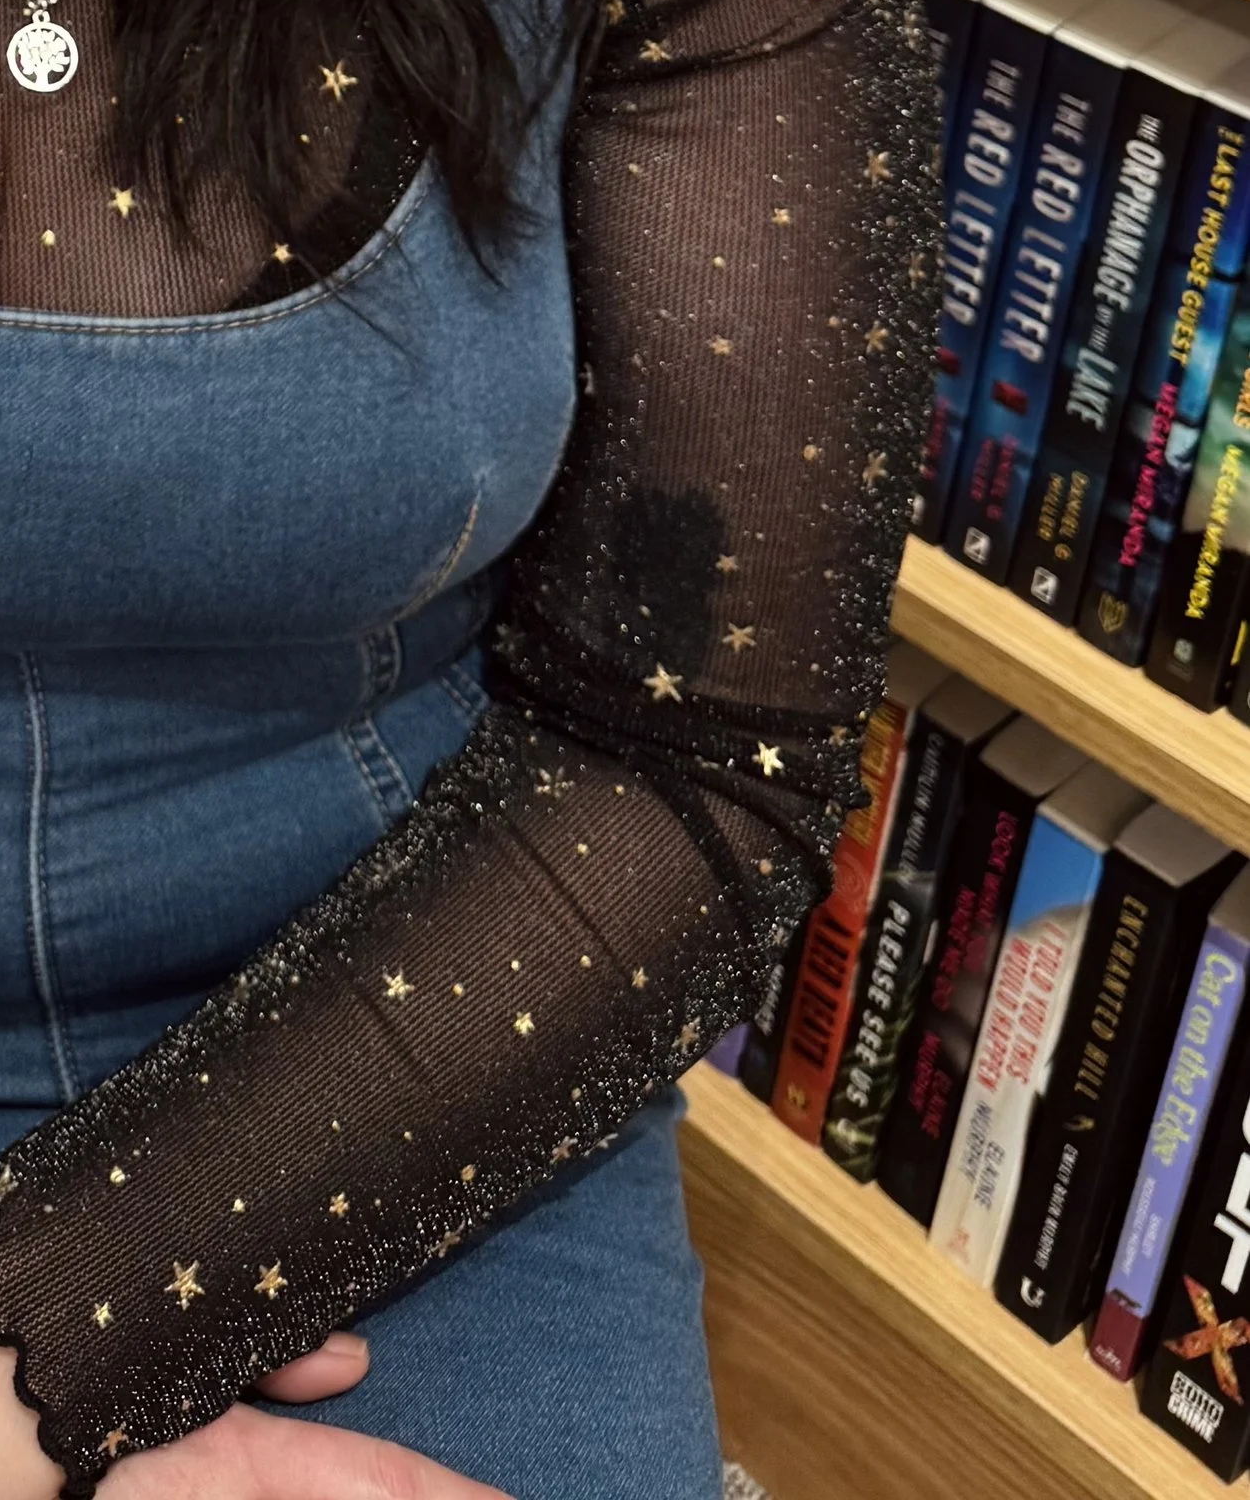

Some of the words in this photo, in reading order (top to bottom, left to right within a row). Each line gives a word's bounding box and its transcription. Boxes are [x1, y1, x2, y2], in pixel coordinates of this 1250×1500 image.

[983, 58, 1022, 110] THE
[1051, 92, 1092, 147] THE
[963, 107, 1016, 189] RED
[1031, 142, 1086, 223] RED
[1207, 142, 1241, 208] LAST
[942, 188, 998, 326] LETTER
[1093, 138, 1165, 312] ORPHANAGE
[1186, 207, 1224, 289] HOUSE
[999, 224, 1067, 364] LETTER
[1168, 290, 1204, 367] GUEST
[1066, 348, 1119, 432] LAKE
[1146, 383, 1178, 466] MEGAN
[1118, 465, 1157, 567] MIRANDA
[1209, 444, 1243, 525] MEGAN
[1184, 522, 1224, 619] MIRANDA
[868, 899, 911, 1011] PLEASE
[996, 937, 1032, 1011] WOULD
[1029, 938, 1064, 995] TOLD
[1090, 894, 1149, 1042] ENCHANTED
[1195, 952, 1237, 1008] Cat
[854, 1008, 886, 1067] SEE
[976, 1008, 1014, 1093] HAPPEN
[1019, 996, 1049, 1039] YOU
[1185, 1004, 1214, 1046] on
[846, 1067, 873, 1109] US
[1006, 1035, 1038, 1085] THIS
[1074, 1041, 1110, 1101] HILL
[1170, 1043, 1208, 1096] the
[1152, 1093, 1197, 1167] Edge
[972, 1140, 1006, 1213] ELAINE
[1168, 1394, 1215, 1443] CRIME
[1174, 1372, 1223, 1425] SOHO
